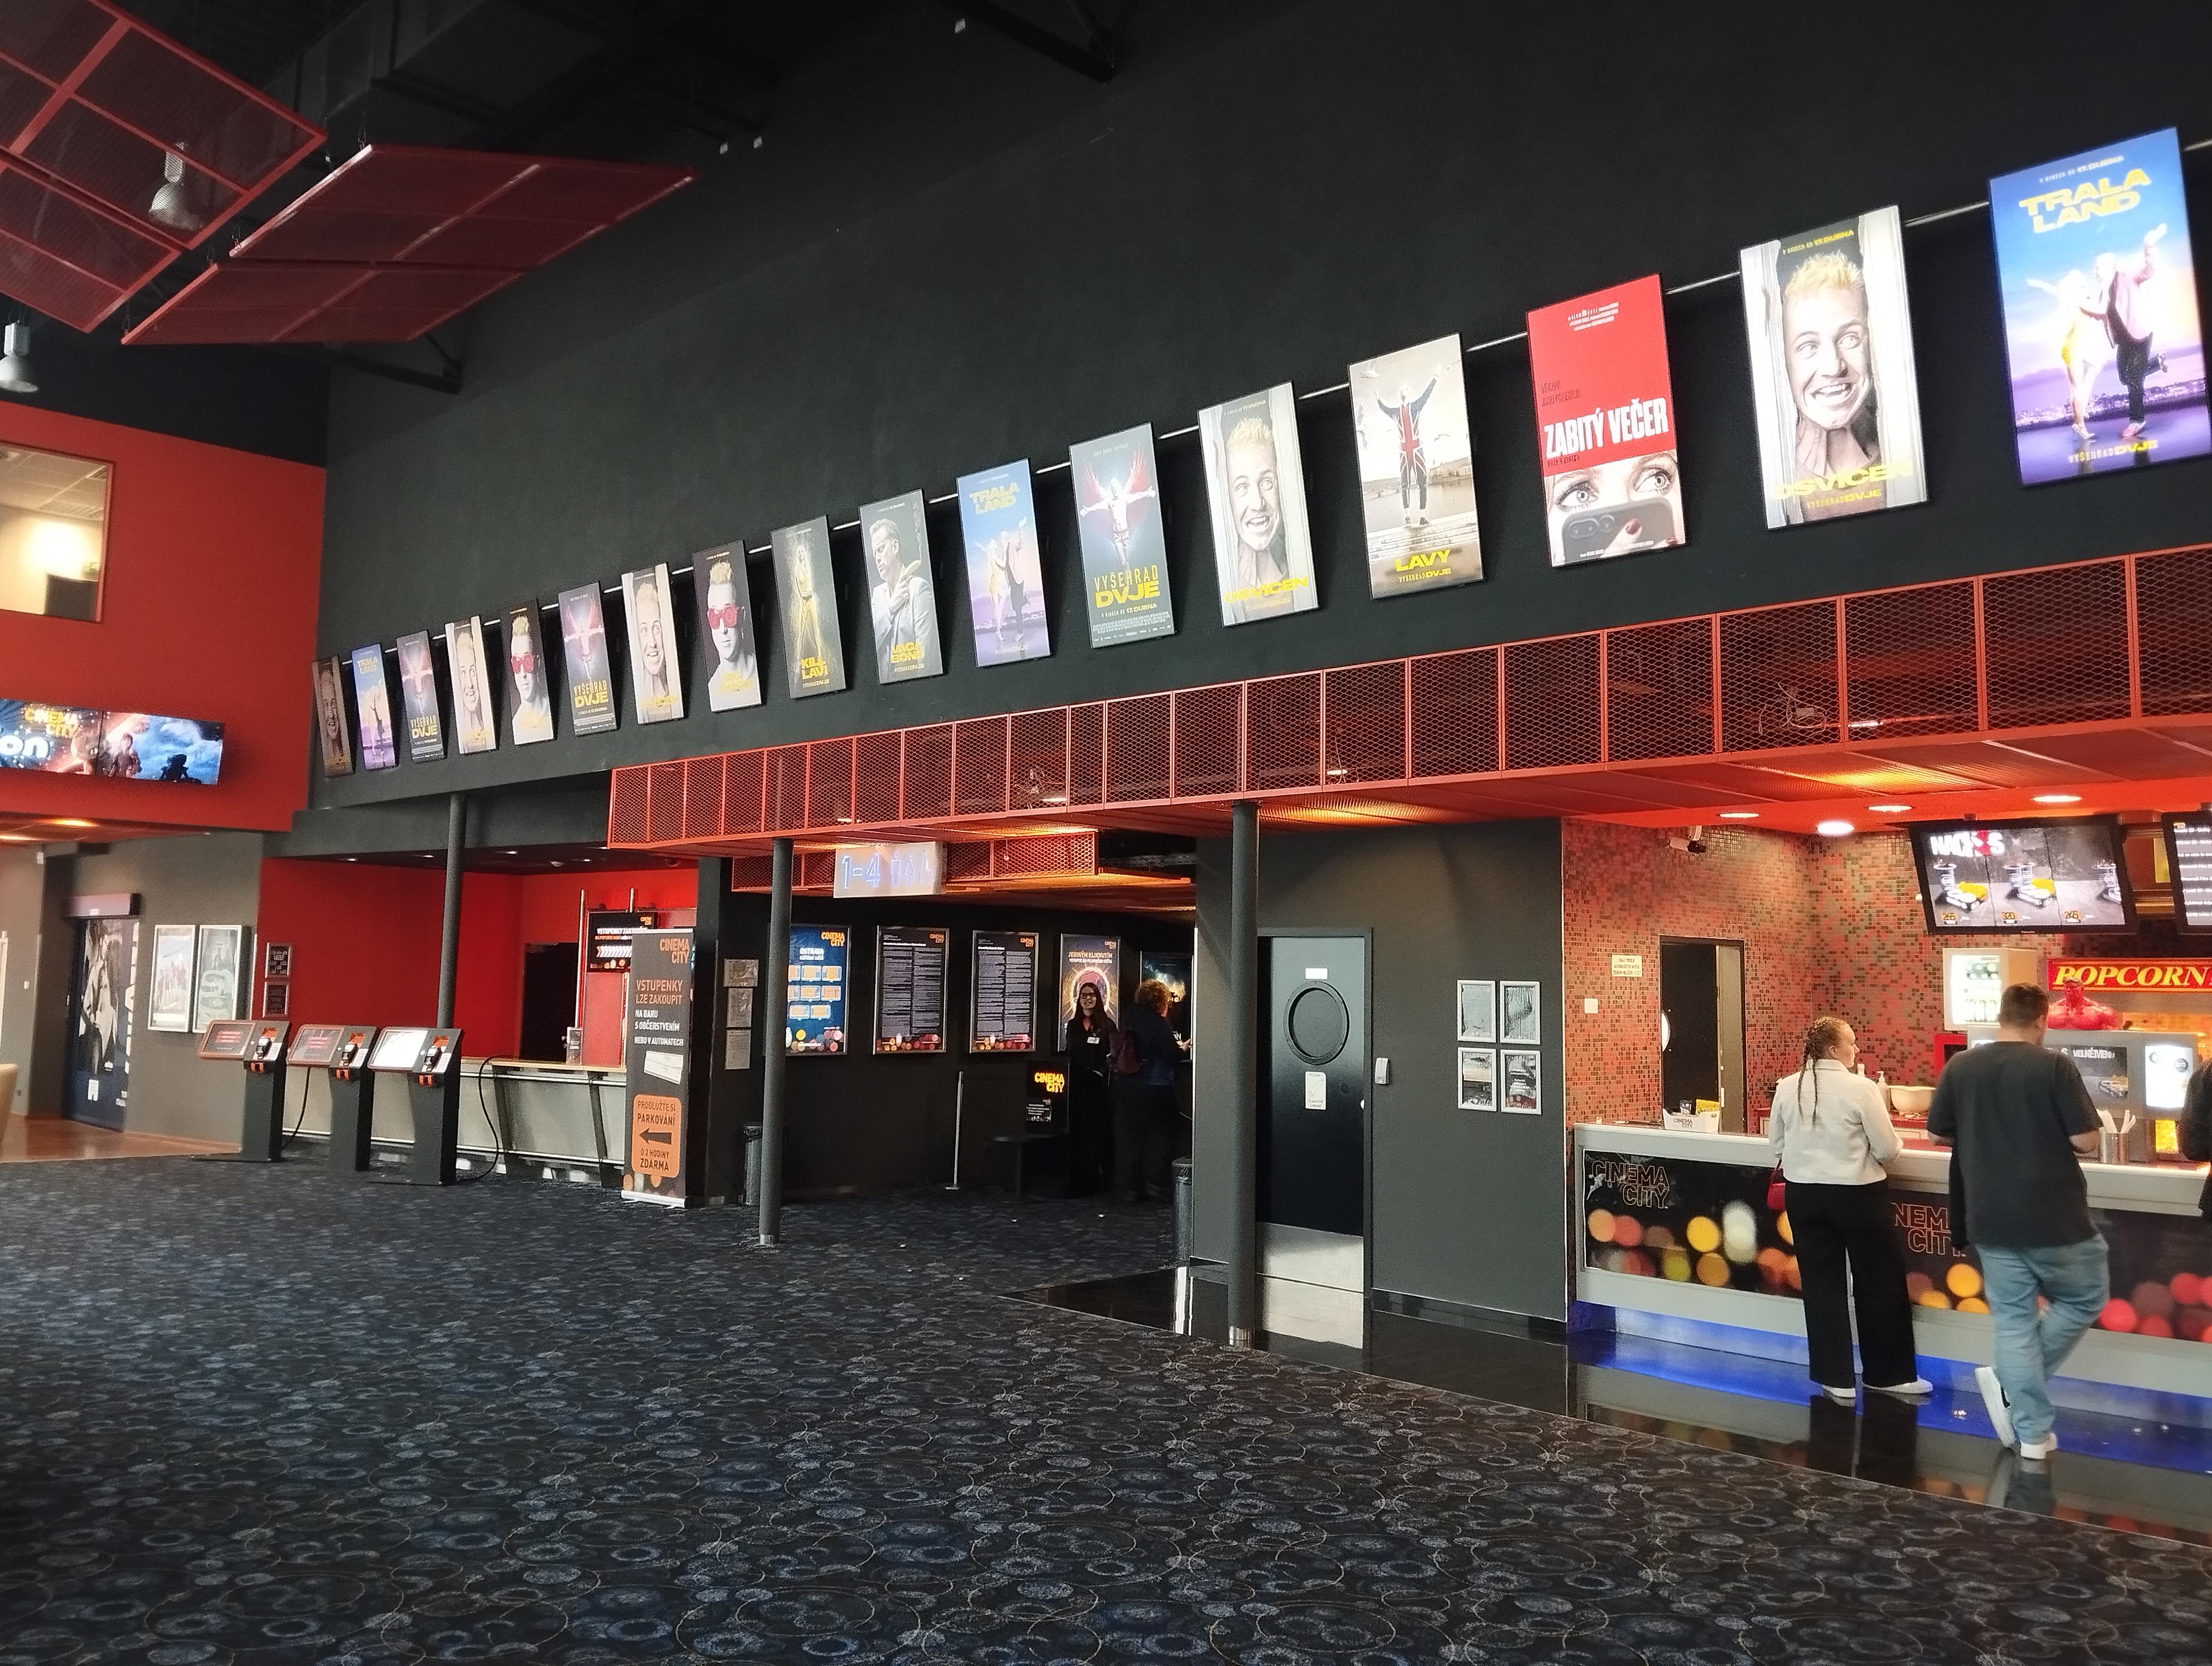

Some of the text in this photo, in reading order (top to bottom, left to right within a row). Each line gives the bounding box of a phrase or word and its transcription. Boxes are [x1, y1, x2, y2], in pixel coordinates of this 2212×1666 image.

[2019, 168, 2151, 216] TRALA
[2033, 190, 2140, 234] LAND
[1544, 398, 1671, 459] ZABITÝ VEČER
[969, 482, 1020, 504] TRALA
[1395, 549, 1451, 572] LAVY
[1094, 565, 1158, 592] VYŠEHRAD
[1095, 580, 1160, 608] DVJE
[801, 656, 826, 669] KILL
[574, 680, 607, 696] VYŠEHRAD
[574, 691, 609, 708] DVJE
[24, 707, 78, 724] CINEMA
[411, 726, 438, 739] DVJE
[821, 931, 844, 941] CINEMA
[660, 939, 690, 951] CINEMA
[671, 951, 690, 964] CITY
[2053, 966, 2210, 986] POPCORN
[636, 980, 683, 992] VSTUPENKY
[636, 993, 682, 1005] LZE ZAKOUPIT
[635, 1009, 658, 1018] NA BARU
[635, 1020, 680, 1031] S ODČERSTVENÍM
[651, 1037, 683, 1046] AUTOMATECH
[1034, 1072, 1065, 1083] CINEMA
[1047, 1082, 1064, 1093] CITY
[637, 1101, 676, 1112] PRODLUŽTE SI
[637, 1113, 675, 1126] PARKOVÁNÍ
[650, 1149, 670, 1158] HODINY
[640, 1158, 669, 1171] ZDARMA
[1592, 1160, 1669, 1187] CINEMA
[1623, 1185, 1669, 1209] CITY
